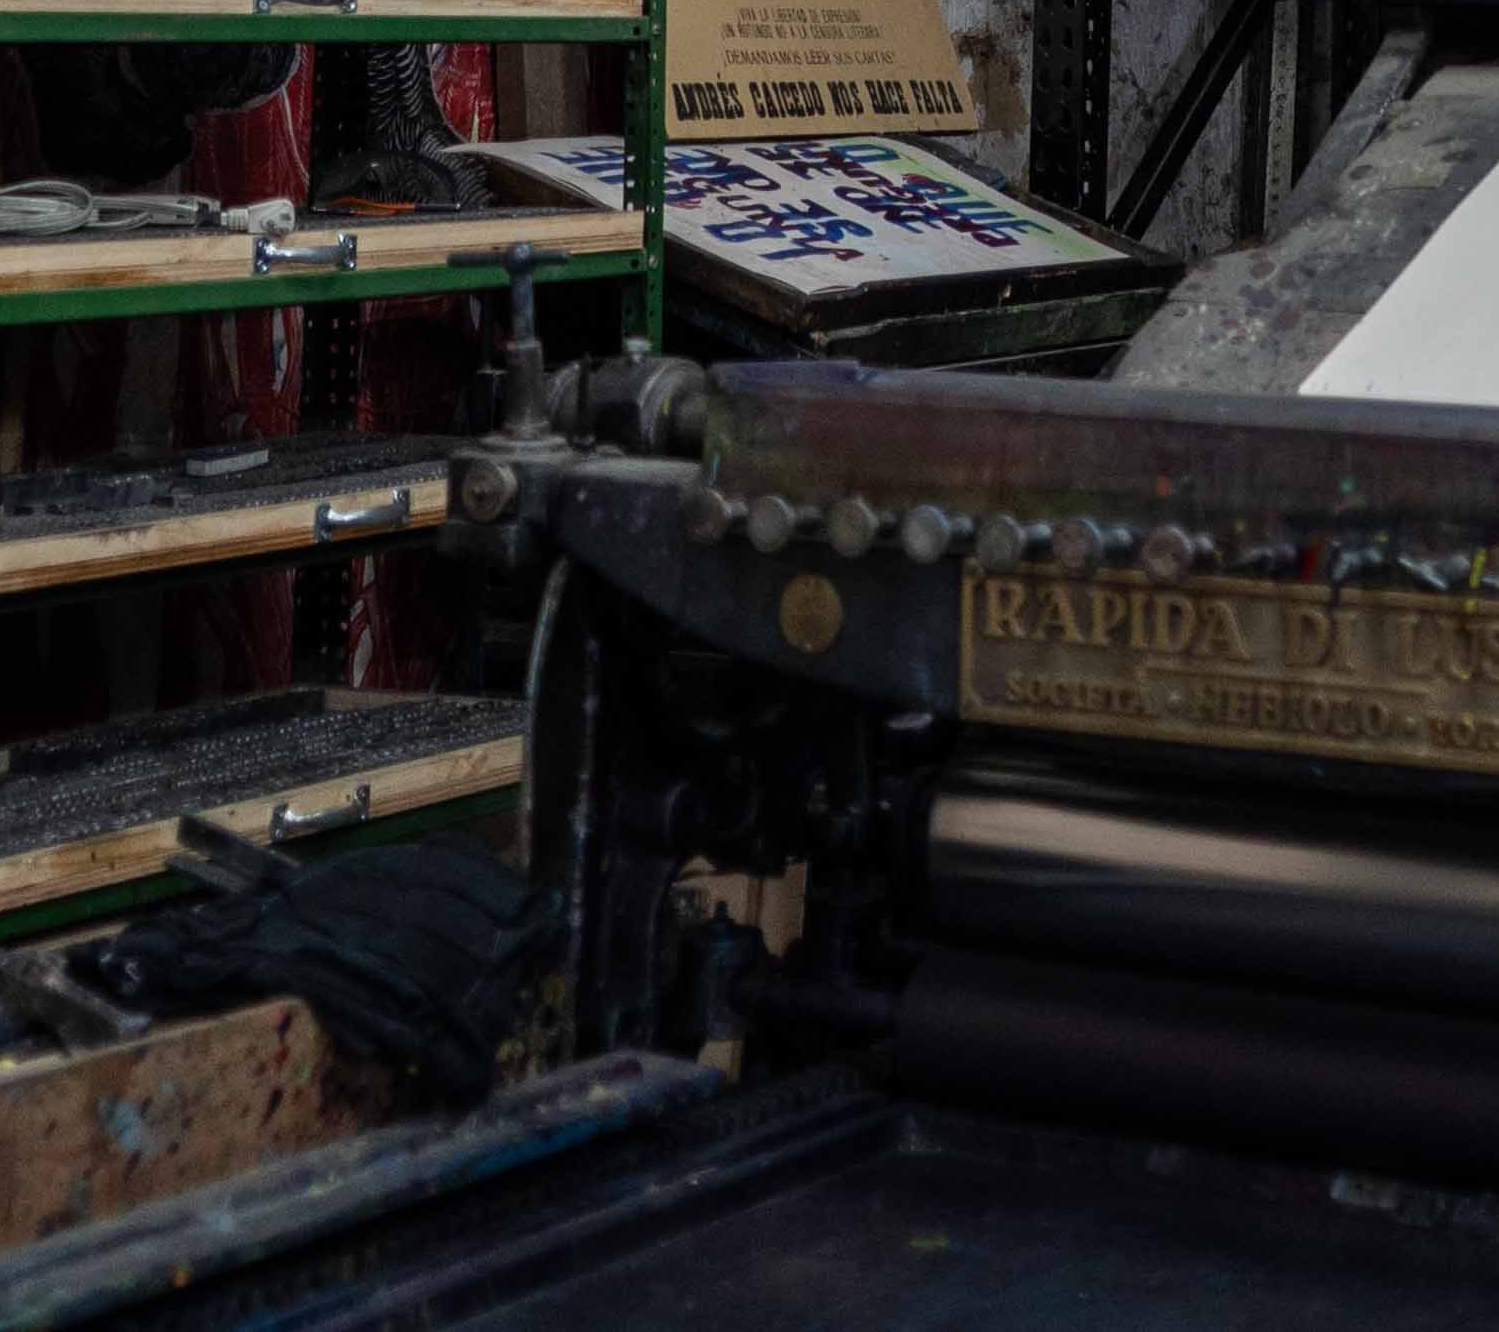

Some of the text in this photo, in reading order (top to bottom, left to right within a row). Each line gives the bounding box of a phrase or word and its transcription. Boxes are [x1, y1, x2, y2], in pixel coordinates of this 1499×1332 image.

[748, 81, 826, 119] CAICEDO
[827, 80, 864, 117] NOS
[864, 79, 910, 116] HACE
[909, 78, 964, 115] FALTA
[984, 579, 1253, 660] RAPIDA
[1279, 601, 1358, 674] DI
